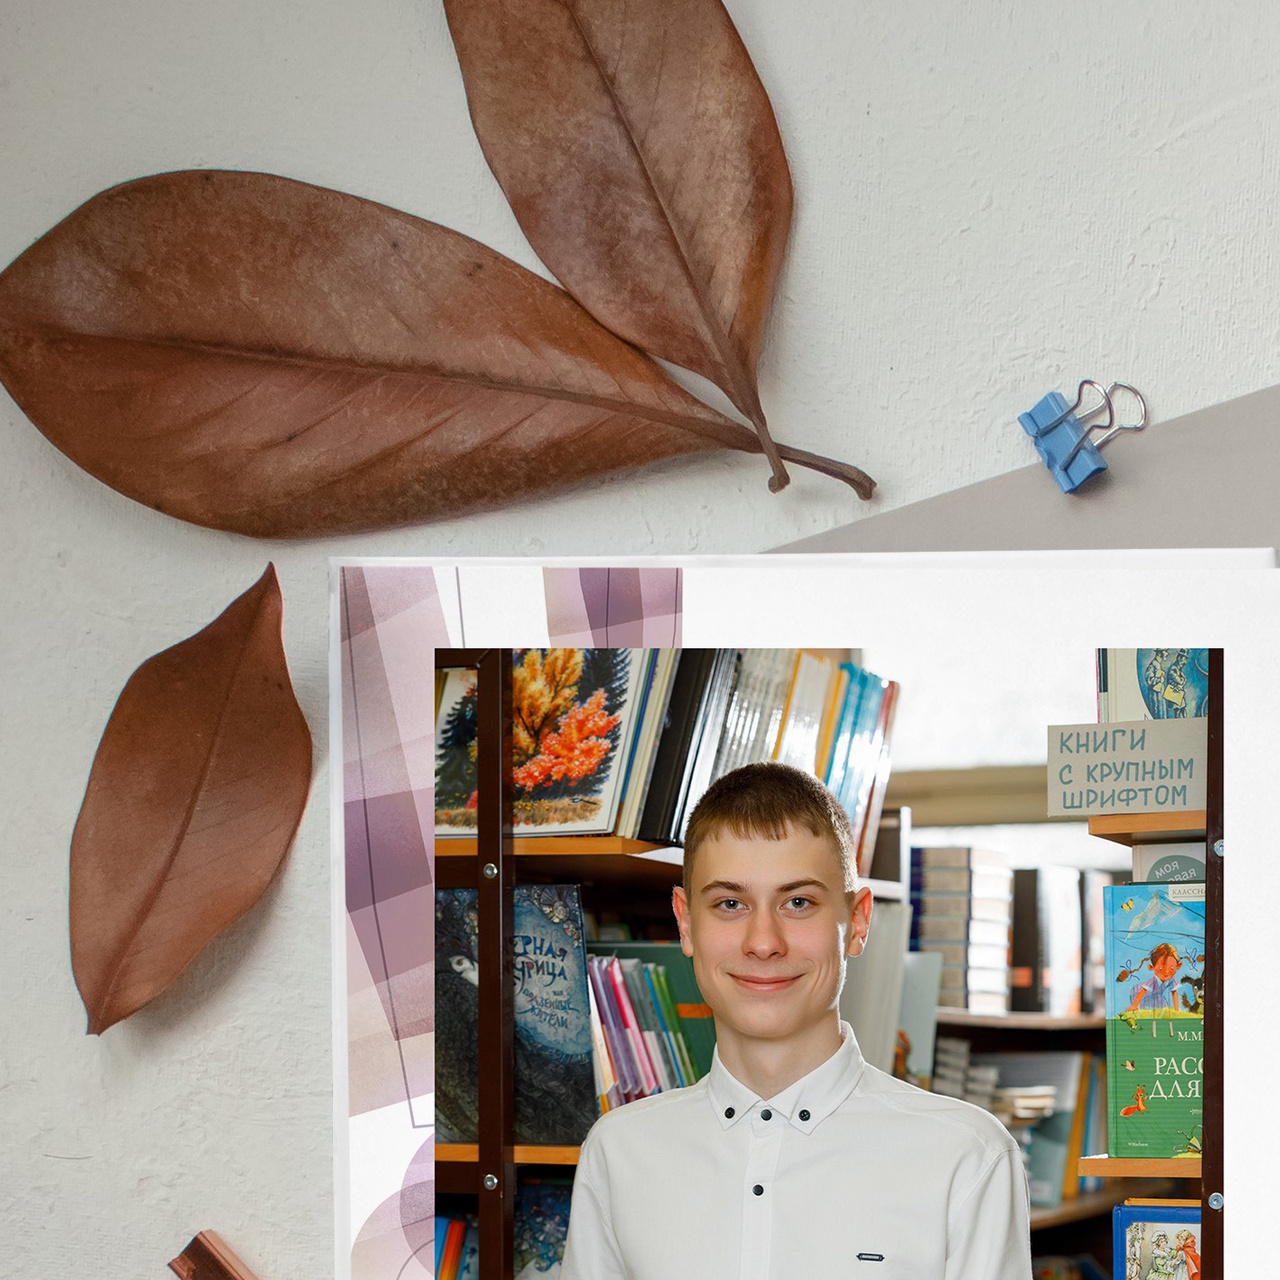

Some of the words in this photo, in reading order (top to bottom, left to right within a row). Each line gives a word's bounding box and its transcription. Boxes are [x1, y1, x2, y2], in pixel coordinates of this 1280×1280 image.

[1059, 728, 1146, 754] КНИГИ
[1058, 763, 1073, 785] С
[1086, 758, 1194, 783] КРУПНЫМ
[1062, 784, 1187, 810] ШРИФТОМ
[1154, 861, 1179, 879] моя
[513, 956, 568, 997] УРИЦА
[1148, 1079, 1202, 1101] ДЛЯ
